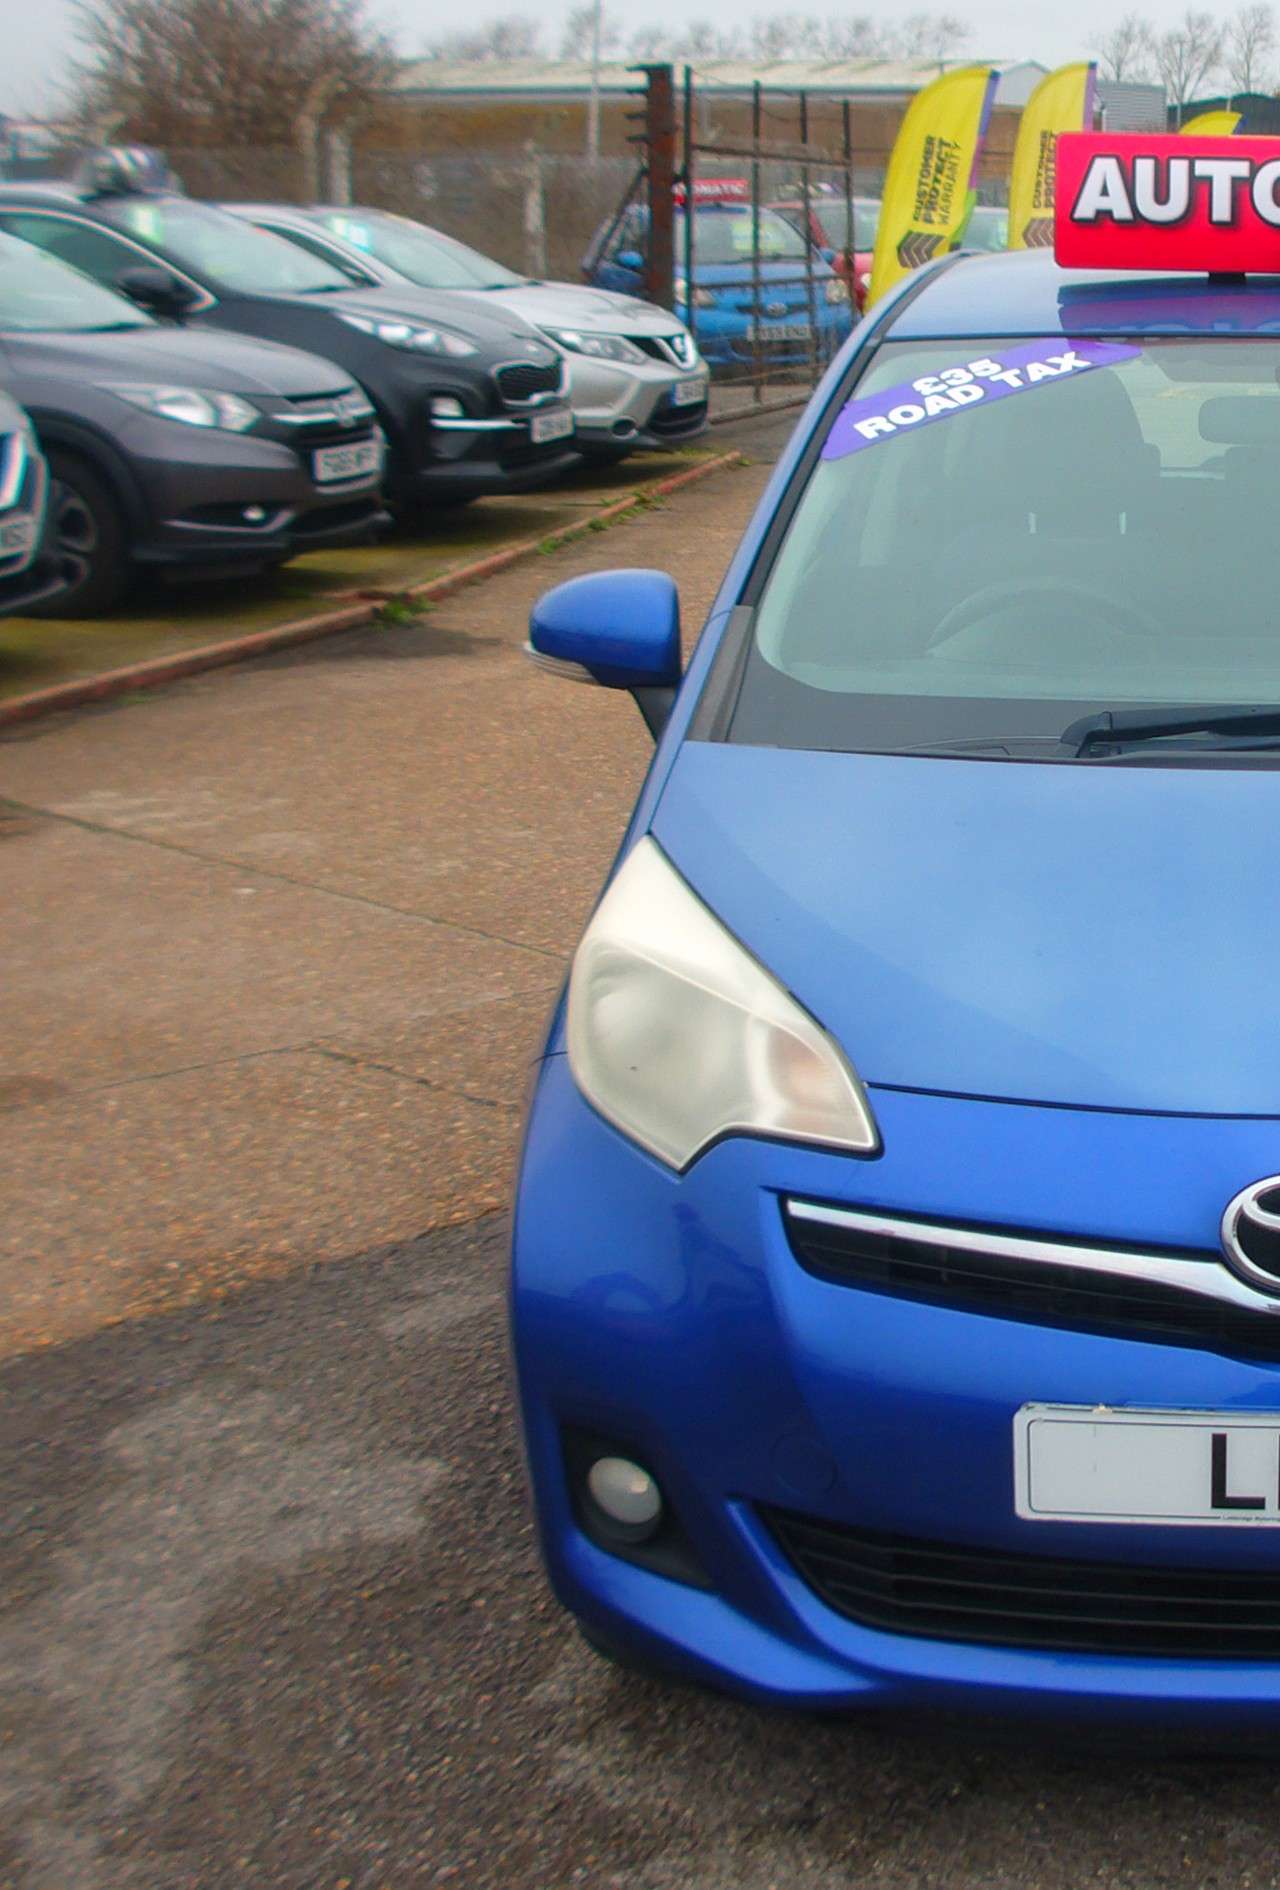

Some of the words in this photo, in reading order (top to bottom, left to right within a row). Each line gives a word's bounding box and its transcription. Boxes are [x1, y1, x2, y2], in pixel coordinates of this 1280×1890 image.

[912, 134, 936, 222] CUSTOMER
[921, 137, 951, 224] PROTECT
[938, 139, 961, 225] WARRANTY
[853, 384, 985, 439] ROAD
[990, 351, 1091, 389] TAX
[912, 358, 1002, 396] £35
